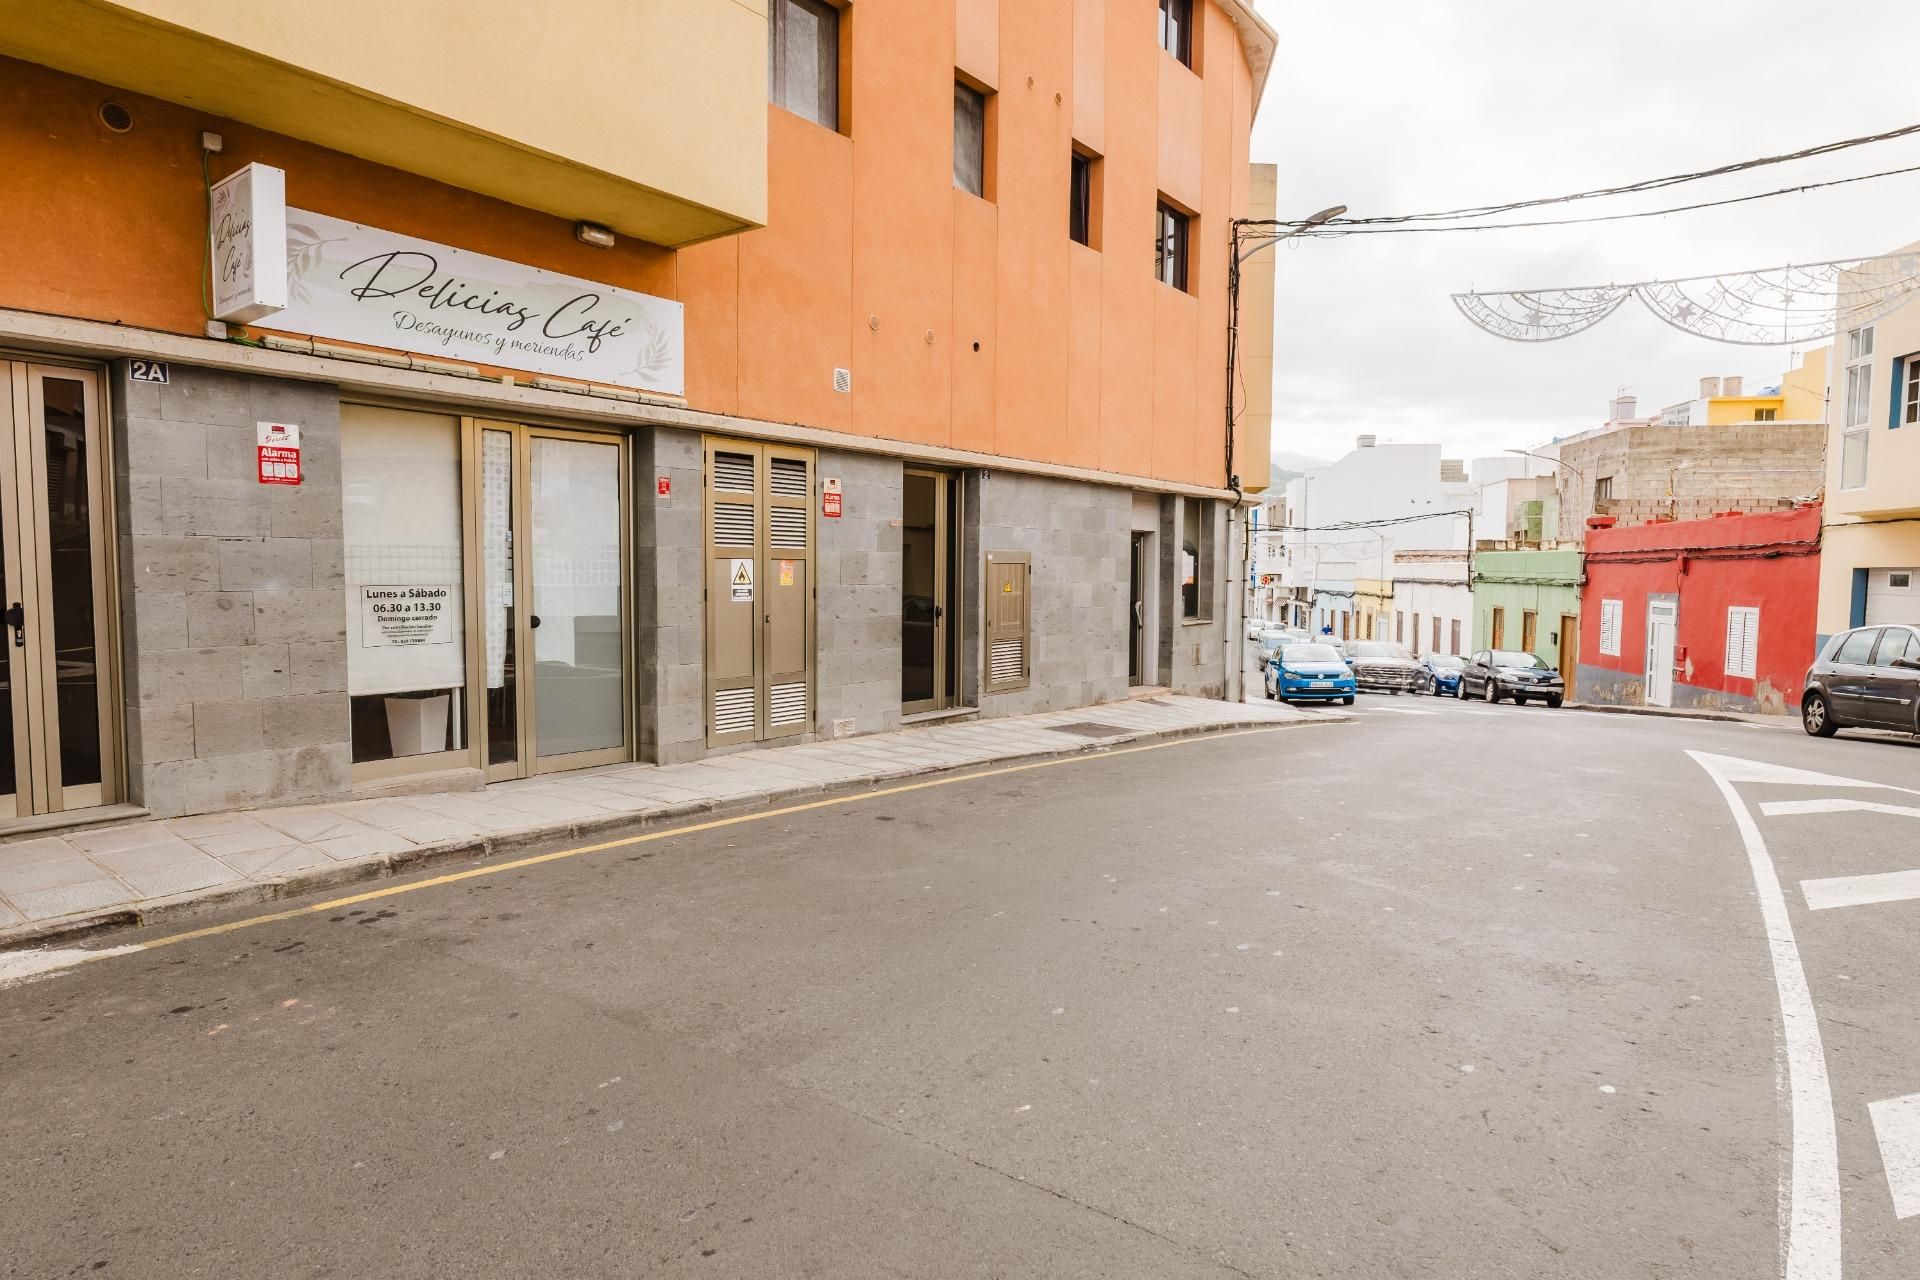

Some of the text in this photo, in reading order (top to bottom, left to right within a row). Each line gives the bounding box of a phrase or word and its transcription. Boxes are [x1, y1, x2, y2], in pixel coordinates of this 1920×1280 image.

[215, 209, 251, 250] Delicias
[223, 245, 242, 282] Café
[340, 251, 632, 353] Delicias Café
[393, 311, 584, 361] Desayunos y meriendas
[133, 361, 165, 382] 2A
[261, 447, 297, 459] Alarma
[983, 470, 989, 479] 2
[366, 589, 398, 599] Lunes
[408, 588, 447, 598] Sábado
[373, 603, 402, 613] 06.30
[414, 602, 441, 611] 13.30
[377, 615, 410, 623] Domingo
